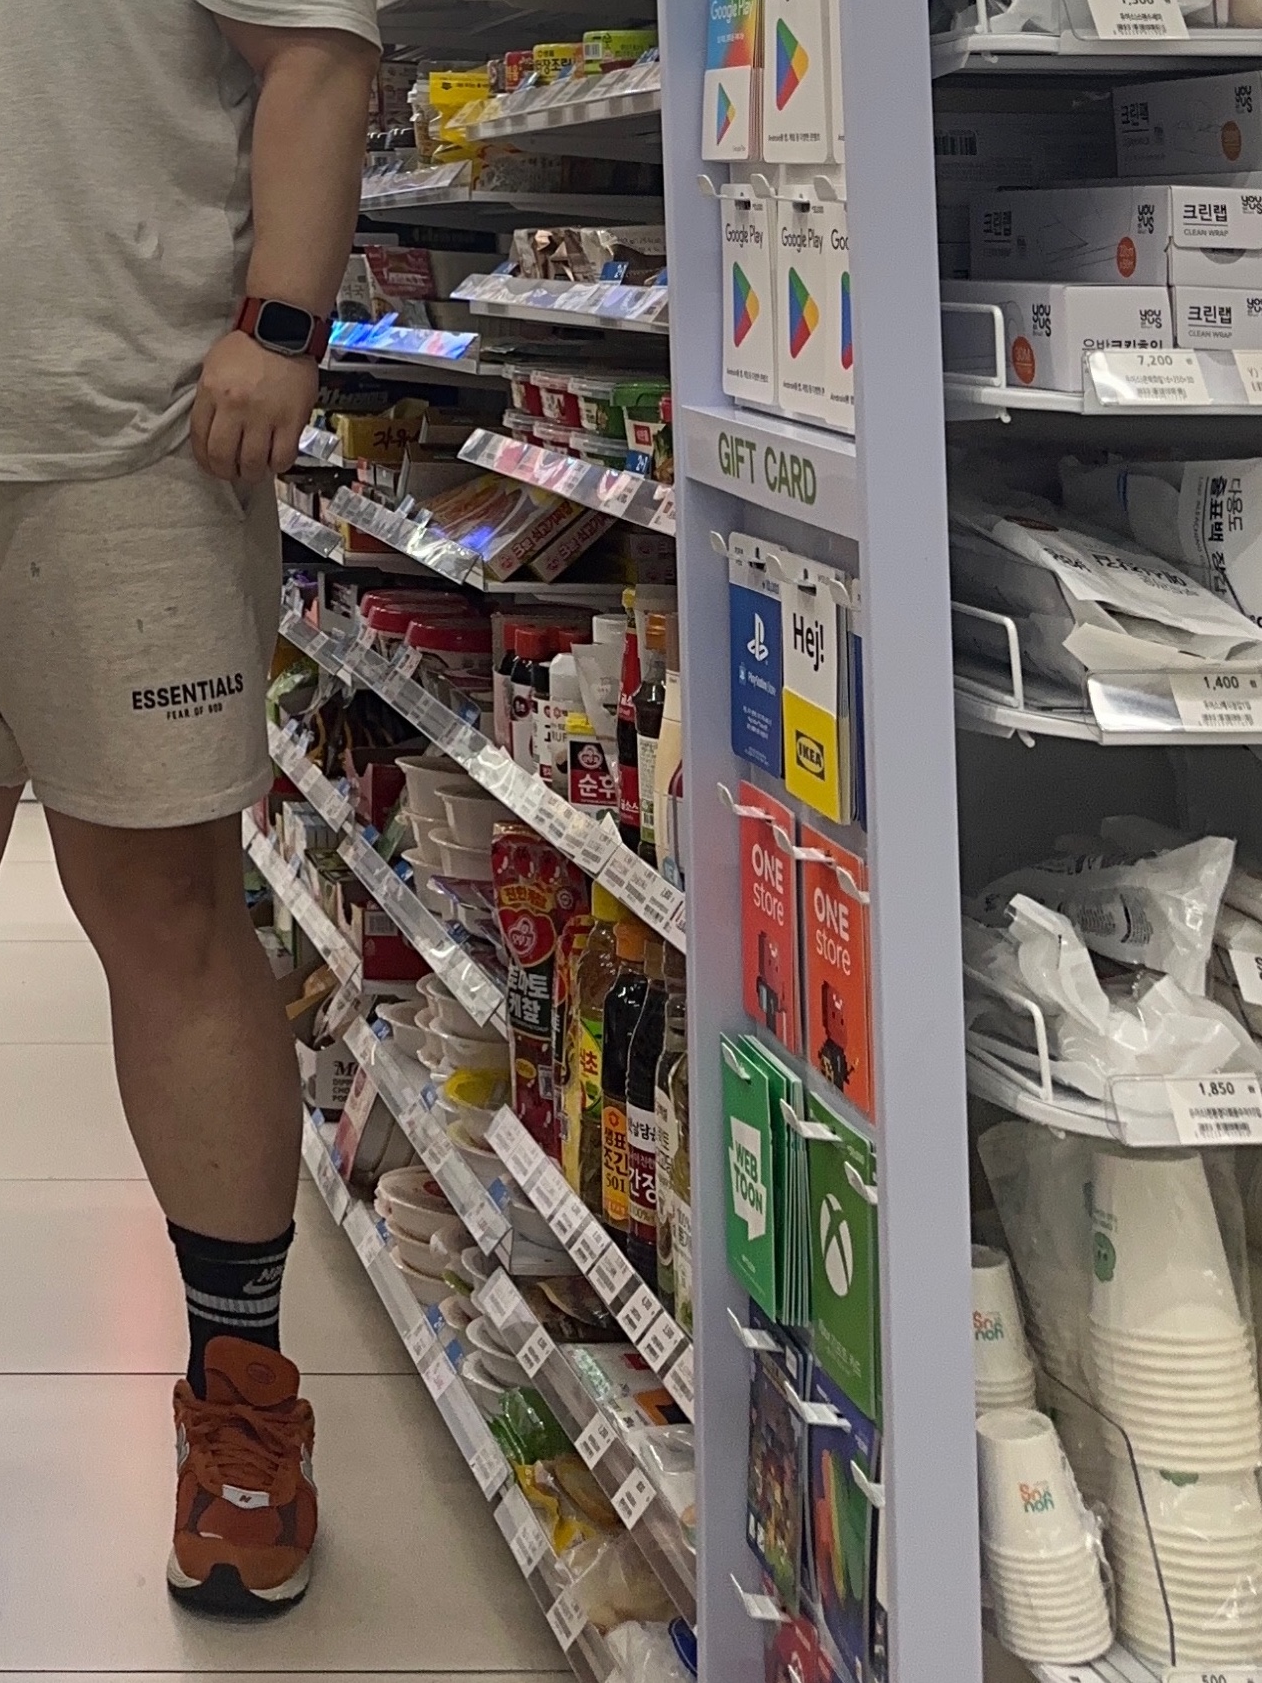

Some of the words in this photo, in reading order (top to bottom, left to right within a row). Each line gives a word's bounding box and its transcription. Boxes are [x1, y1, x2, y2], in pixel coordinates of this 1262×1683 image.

[710, 0, 737, 23] Google
[1183, 204, 1228, 223] 크린랩
[725, 223, 748, 249] Google
[748, 225, 764, 249] Play
[781, 226, 807, 254] Google
[807, 229, 823, 254] Play
[1184, 229, 1207, 237] CLEAN
[1208, 229, 1229, 237] WRAP
[1188, 306, 1232, 324] 크린랩
[1188, 330, 1210, 338] CLEAN
[1212, 331, 1232, 339] WRAP
[1137, 355, 1173, 367] 7,200
[373, 428, 419, 450] 자유
[718, 431, 757, 485] GIFT
[764, 446, 817, 506] CARD
[1227, 478, 1243, 532] 다용도
[793, 612, 825, 673] Hej!
[132, 673, 244, 710] ESSENTIALS
[1204, 676, 1239, 690] 1,400
[166, 708, 190, 720] FEAR
[194, 706, 204, 717] OF
[208, 702, 223, 714] GOD
[798, 740, 823, 768] IKEA
[578, 773, 616, 798] 순후
[751, 843, 784, 894] ONE
[753, 882, 784, 926] store
[814, 887, 849, 942] ONE
[816, 928, 851, 976] store
[507, 968, 549, 998] 토마토
[1199, 1083, 1235, 1096] 1,850
[735, 1141, 757, 1184] WEB
[733, 1166, 763, 1215] TOON
